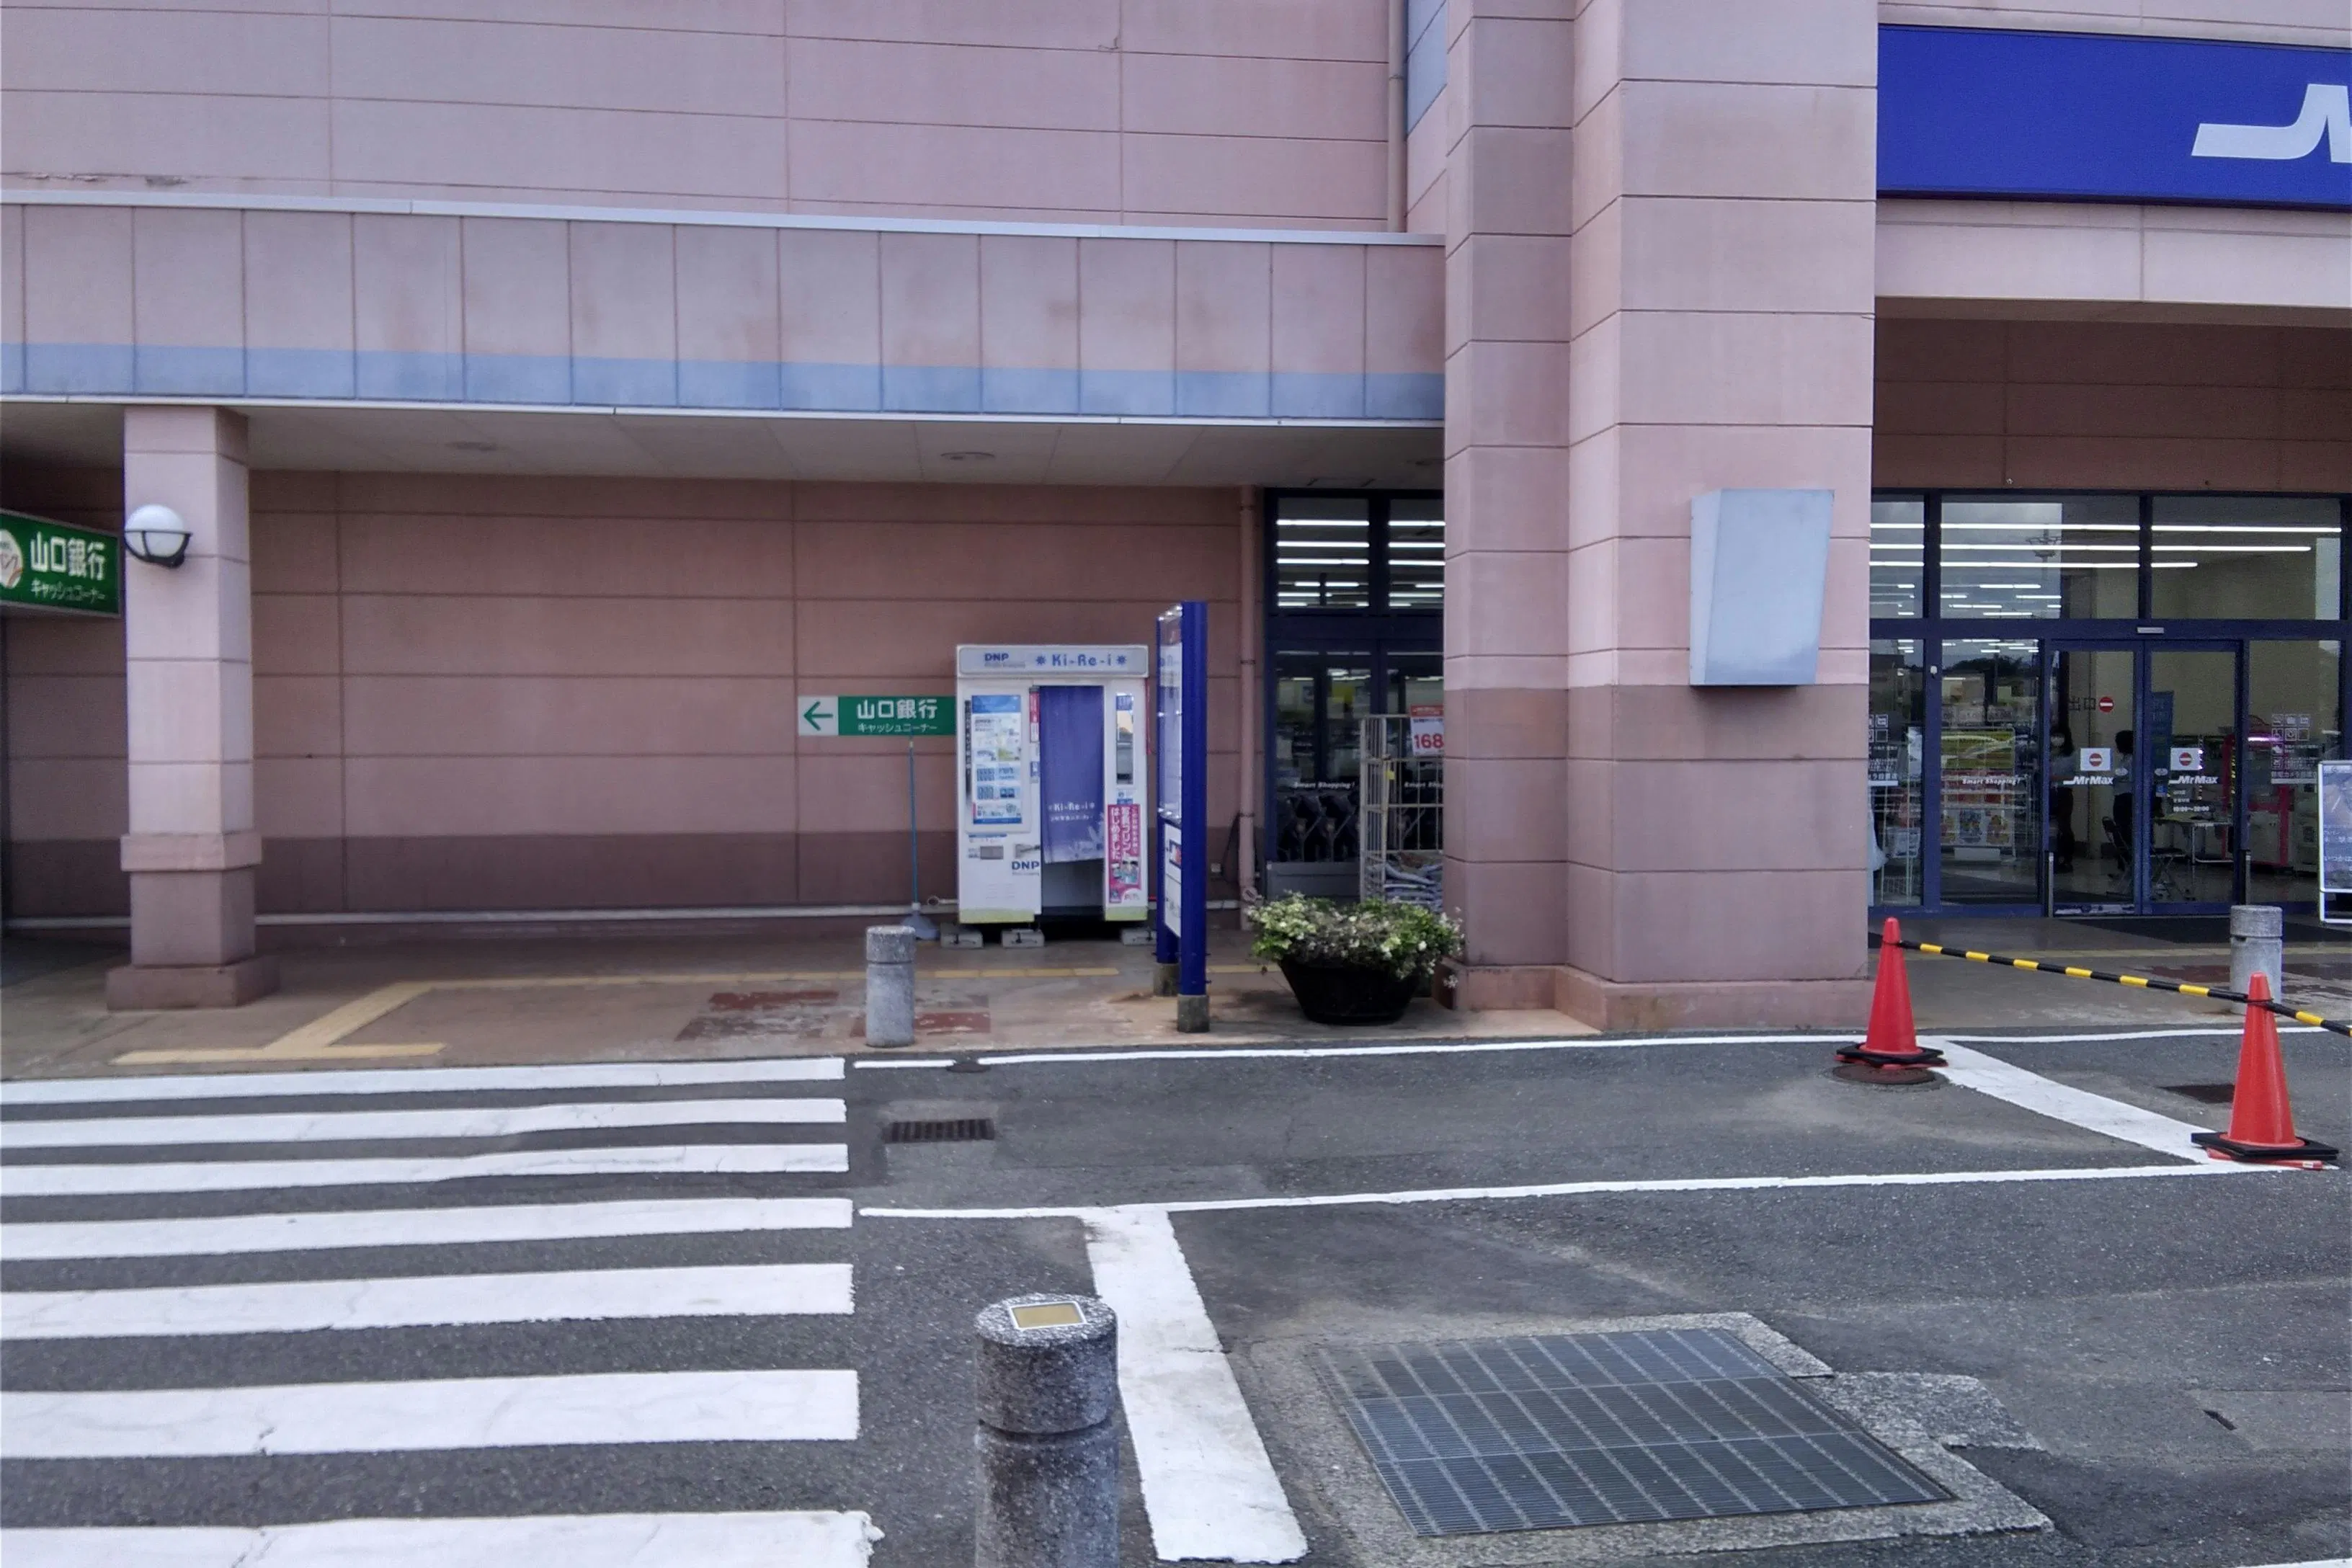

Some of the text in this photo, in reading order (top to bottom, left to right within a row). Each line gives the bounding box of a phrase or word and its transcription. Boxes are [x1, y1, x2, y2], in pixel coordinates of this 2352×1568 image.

[30, 531, 105, 581] 山口銀行
[31, 579, 106, 604] キャッシュコーナー
[984, 653, 1009, 662] DNP
[857, 699, 937, 719] 山口銀行
[858, 722, 937, 734] キャッシュコーナー
[2063, 775, 2113, 785] MrMax
[2168, 775, 2219, 785] MrMax
[1110, 806, 1121, 860] はじめました
[1012, 860, 1040, 870] DNP
